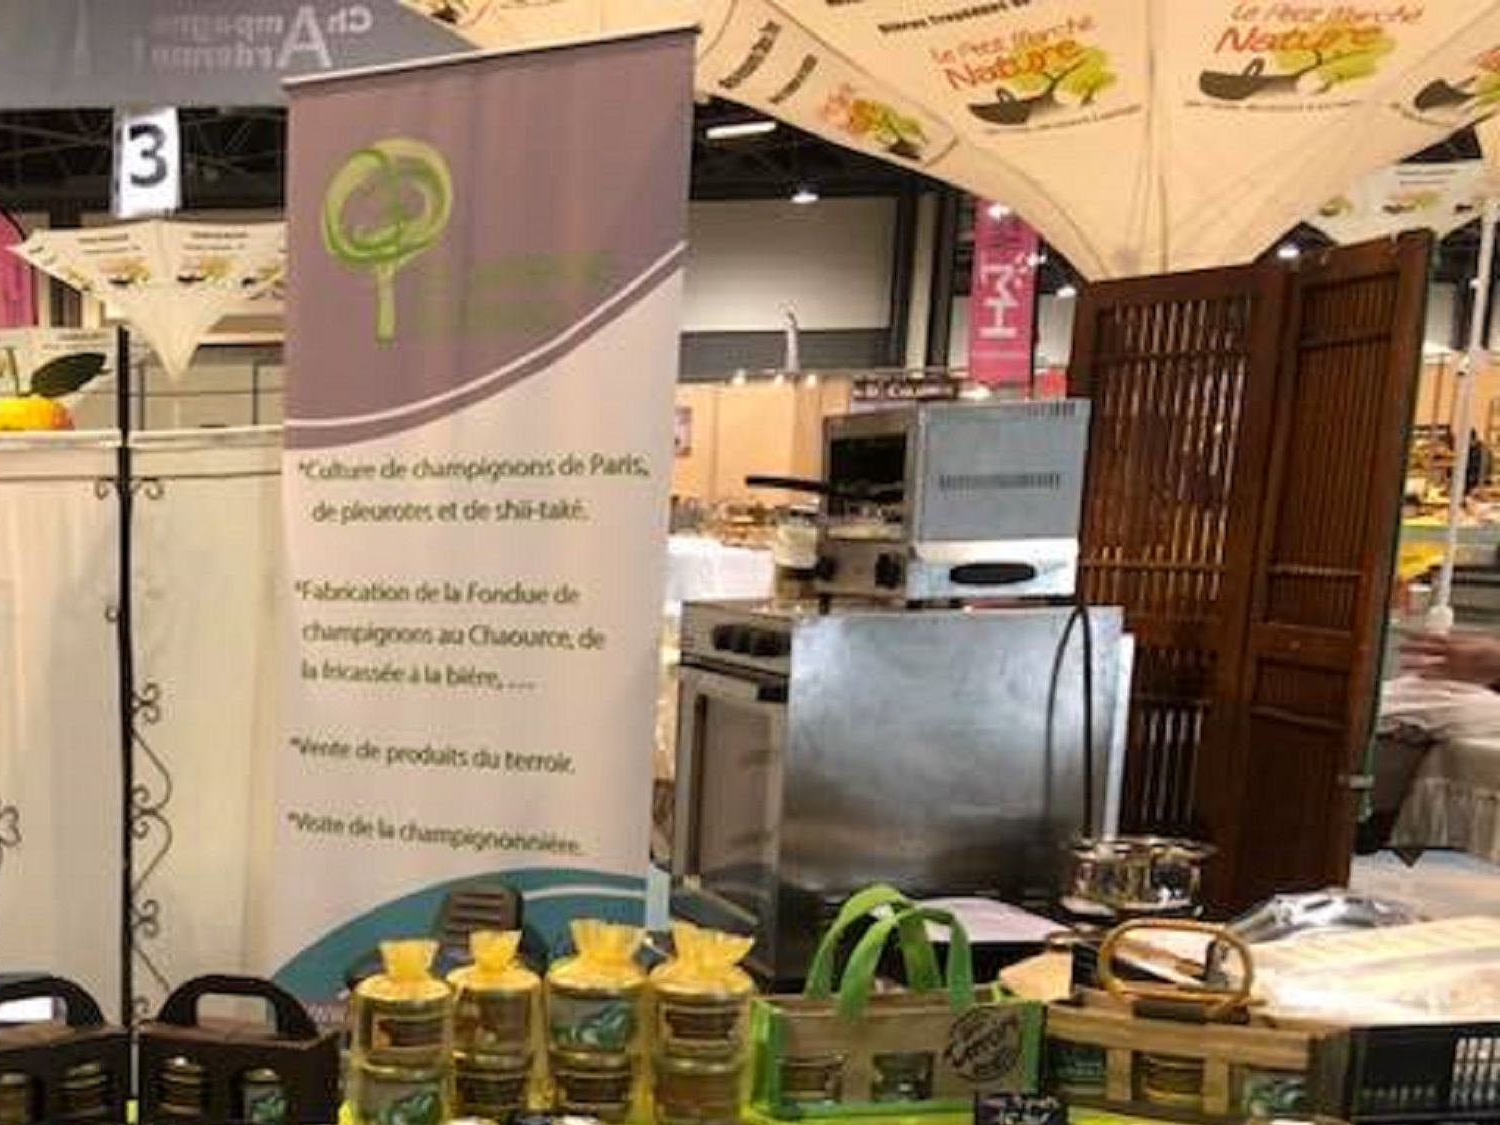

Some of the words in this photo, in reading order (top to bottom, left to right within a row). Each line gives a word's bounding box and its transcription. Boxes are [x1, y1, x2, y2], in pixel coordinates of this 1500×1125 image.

[1214, 25, 1383, 54] Nature
[945, 39, 1077, 90] Nature
[128, 123, 167, 189] 3
[380, 458, 406, 479] de
[412, 454, 554, 483] champignons
[559, 455, 586, 476] de
[589, 452, 650, 477] Paris,
[312, 501, 338, 522] de
[340, 501, 433, 525] pleurotes
[438, 501, 458, 520] et
[463, 500, 490, 521] de
[415, 582, 440, 602] de
[444, 582, 461, 602] la
[466, 581, 550, 604] Fondue
[553, 583, 580, 604] de
[302, 620, 433, 647] champignons
[438, 627, 464, 645] au
[468, 624, 575, 650] Chaource,
[577, 627, 606, 650] de
[301, 659, 318, 679] la
[322, 660, 405, 682] fricassée
[408, 662, 421, 683] à
[424, 663, 442, 683] la
[356, 738, 382, 760] de
[386, 742, 469, 767] produits
[473, 746, 500, 769] du
[348, 814, 374, 836] de
[377, 817, 396, 838] la
